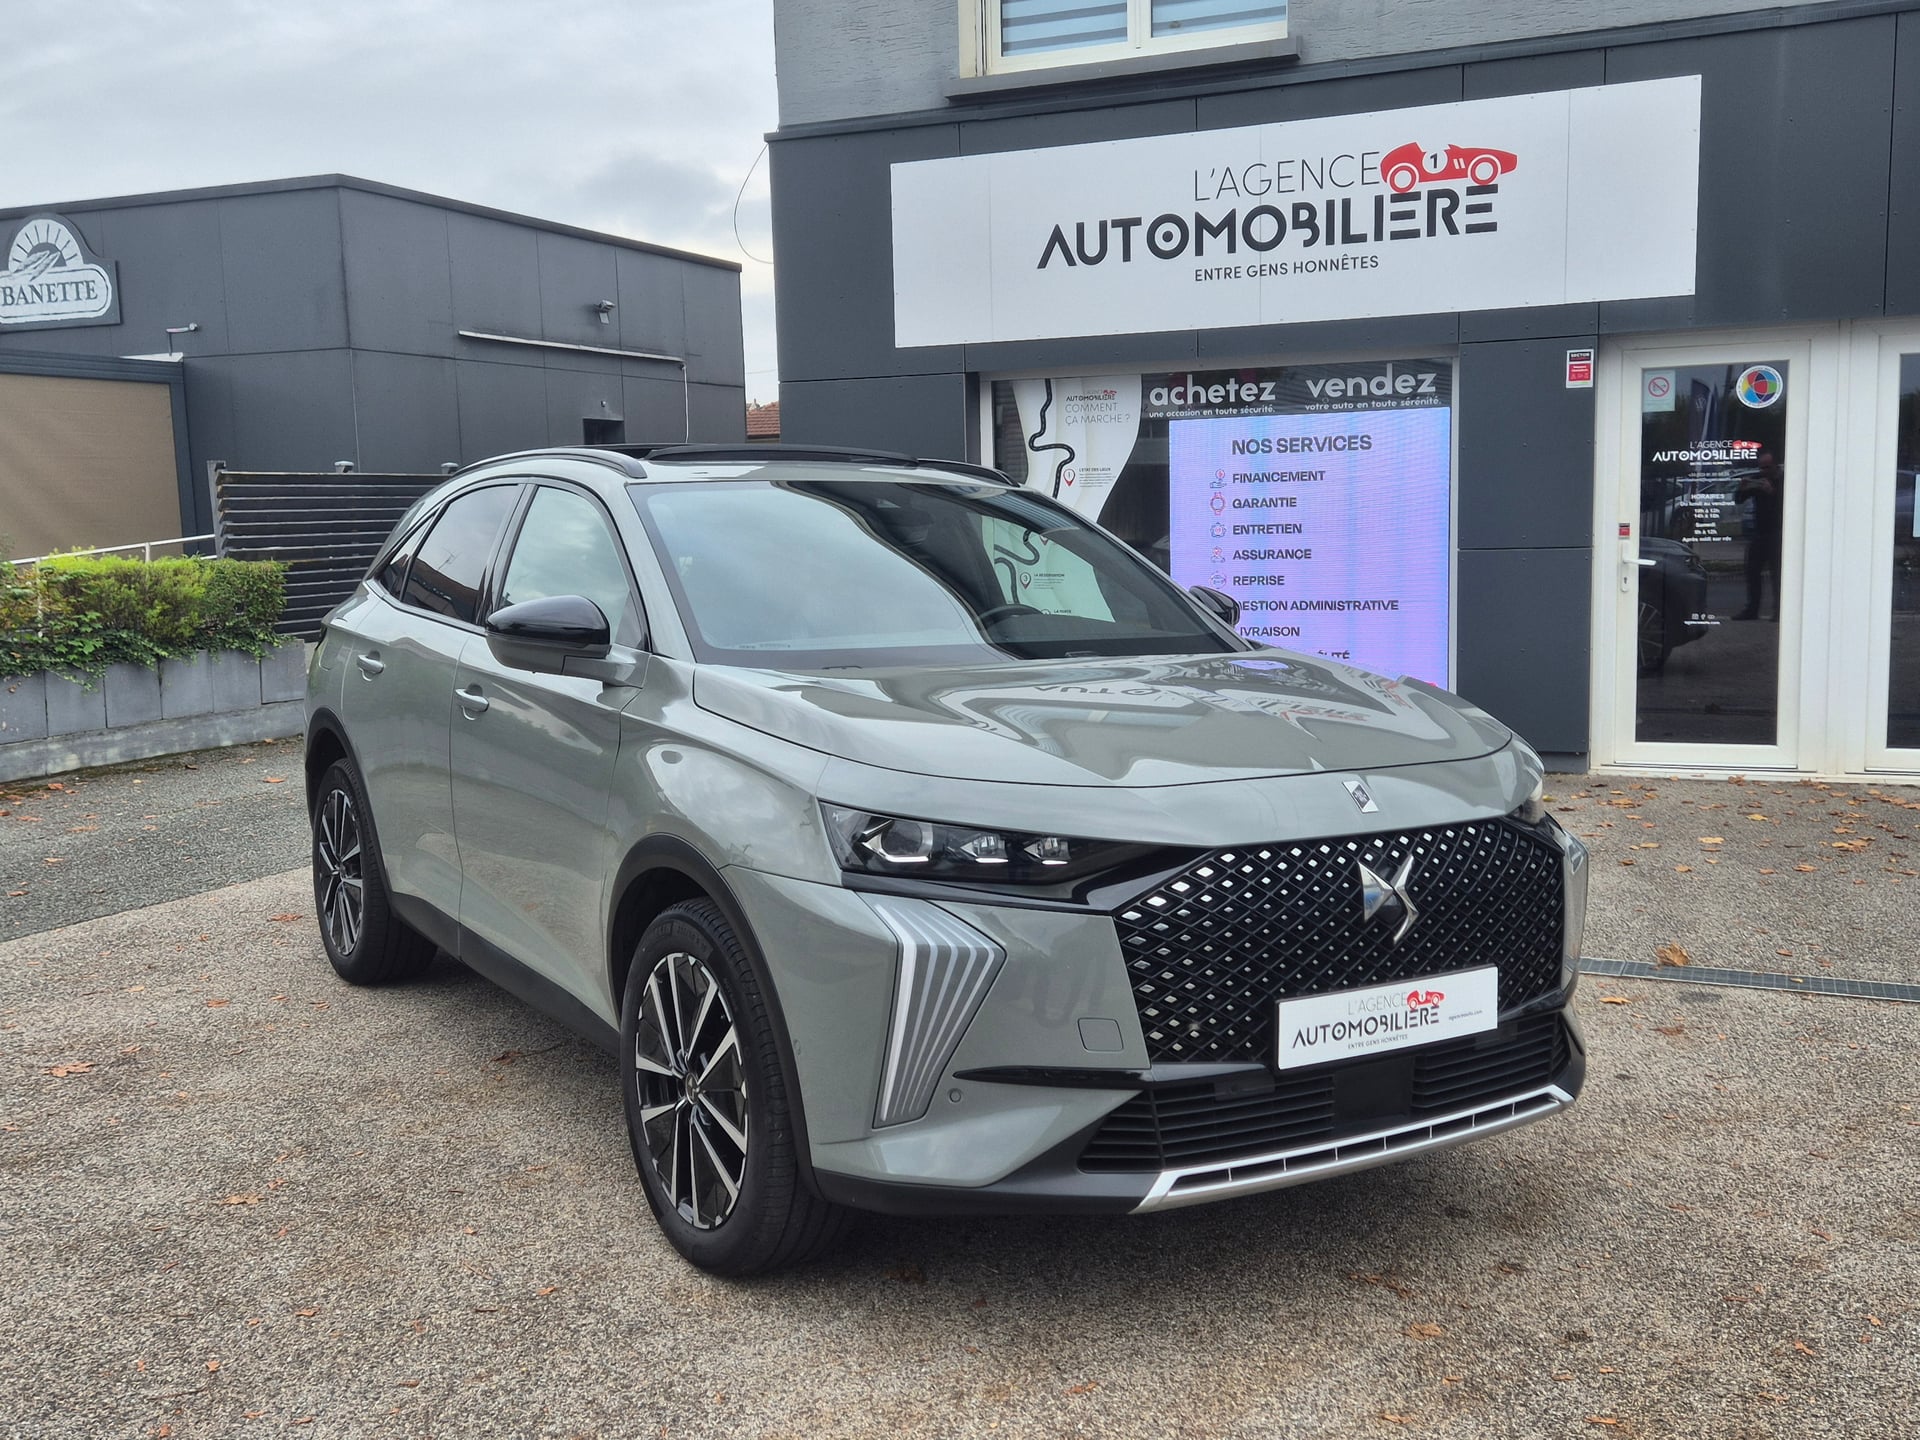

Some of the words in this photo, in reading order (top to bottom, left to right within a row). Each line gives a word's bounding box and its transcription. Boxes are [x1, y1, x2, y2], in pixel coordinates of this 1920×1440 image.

[1429, 152, 1438, 169] 1
[1194, 151, 1380, 201] L'AGENCE
[1195, 266, 1242, 282] ENTRE
[1246, 262, 1288, 278] GENS
[1293, 254, 1379, 274] HONNÊTES
[1, 280, 98, 306] BANETTE
[1306, 363, 1437, 398] vendez
[1149, 374, 1276, 406] achetez
[1065, 402, 1118, 413] COMMENT
[1305, 402, 1329, 411] votre
[1332, 401, 1353, 410] auto
[1371, 400, 1397, 408] toute
[1400, 395, 1442, 407] sérénité.
[1166, 409, 1200, 417] occasion
[1215, 407, 1238, 415] toute
[1240, 404, 1276, 414] sécurité.
[1065, 415, 1078, 427] ÇA
[1081, 413, 1122, 424] MARCHE
[1232, 438, 1273, 455] NOS
[1276, 434, 1372, 454] SERVICES
[1690, 440, 1732, 449] L'AGENCE
[1232, 471, 1326, 483] FINANCEMENT
[1232, 497, 1297, 509] GARANTIE
[1232, 523, 1302, 535] ENTRETIEN
[1232, 549, 1312, 560] ASSURANCE
[1232, 576, 1285, 586] REPRISE
[1290, 600, 1399, 611] ADMINISTRATIVE
[1240, 627, 1300, 637] IVRAISON
[1348, 991, 1407, 1015] L'AGENCE
